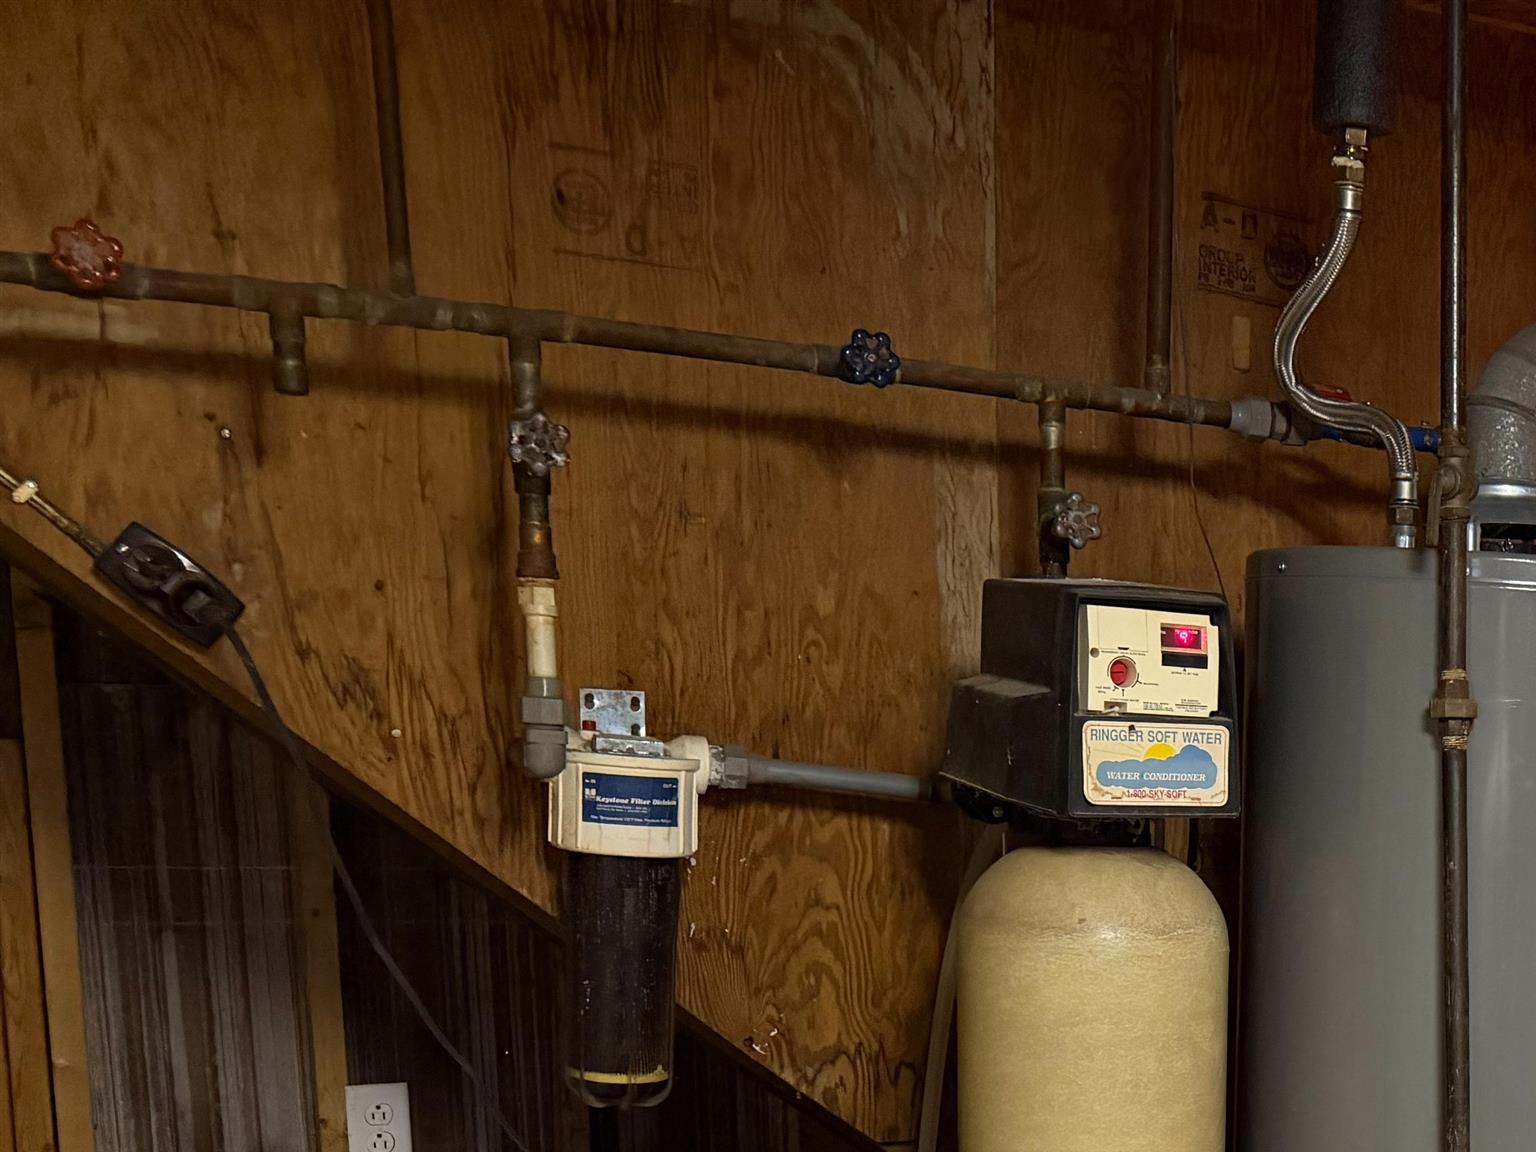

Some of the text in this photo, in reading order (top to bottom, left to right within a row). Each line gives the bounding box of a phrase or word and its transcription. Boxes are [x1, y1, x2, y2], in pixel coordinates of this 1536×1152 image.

[1200, 259, 1256, 284] INTERIOR
[1090, 729, 1222, 745] RINGGER SOFT WATER
[1106, 771, 1206, 782] WATER CONDITIONER
[596, 796, 629, 804] Keystone
